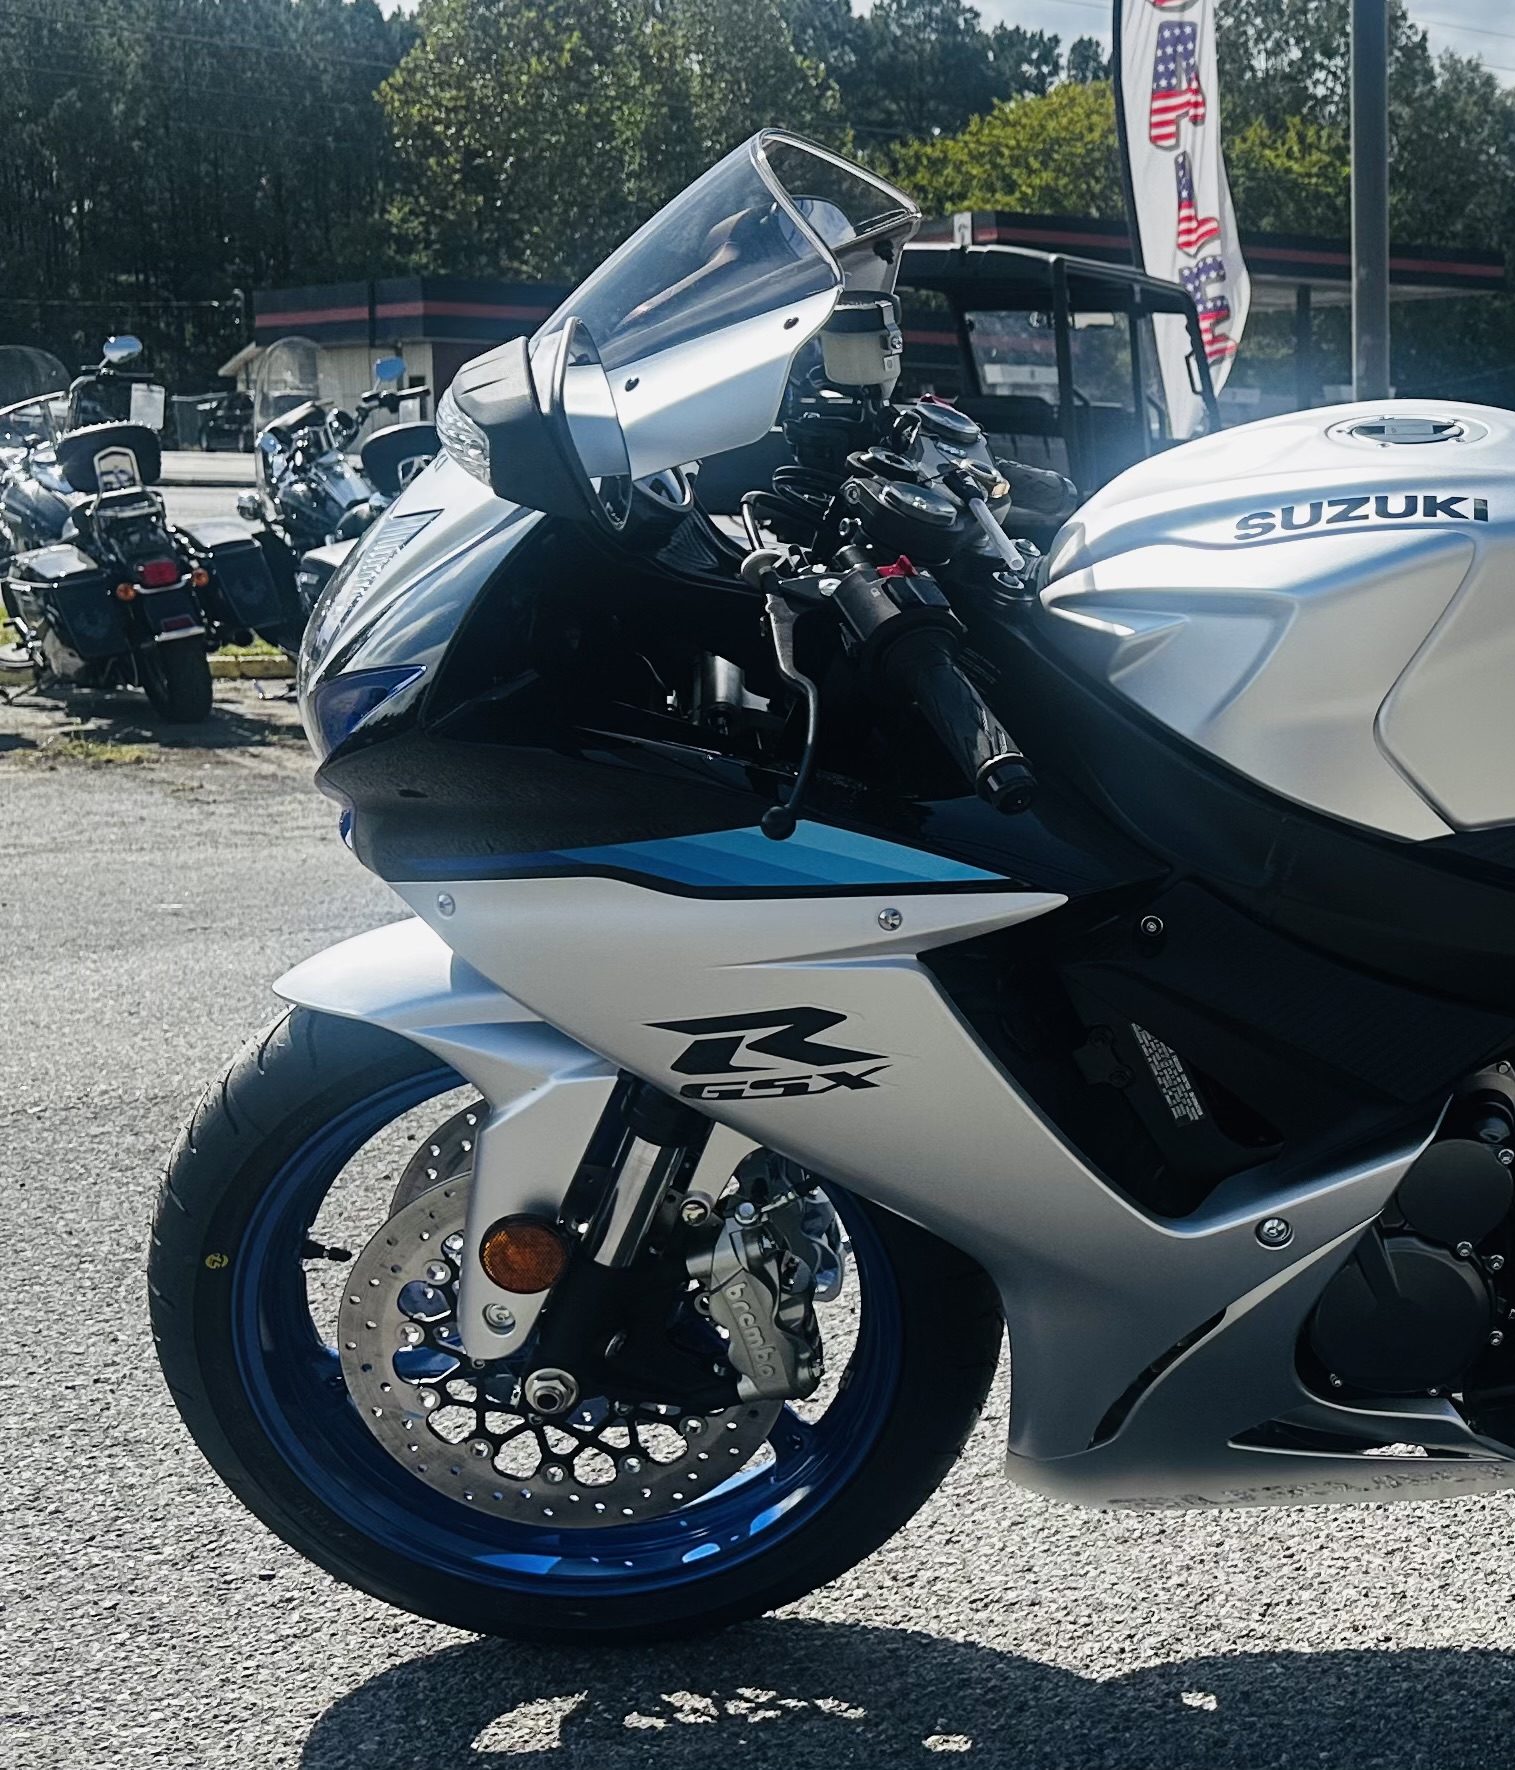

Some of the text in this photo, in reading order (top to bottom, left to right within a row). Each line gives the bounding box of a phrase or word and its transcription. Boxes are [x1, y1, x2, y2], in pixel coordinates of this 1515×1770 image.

[1148, 0, 1238, 367] ALE
[1234, 495, 1488, 541] SUZUKI
[641, 1006, 890, 1075] R
[680, 1064, 893, 1101] GSX
[725, 1281, 776, 1378] brembo
